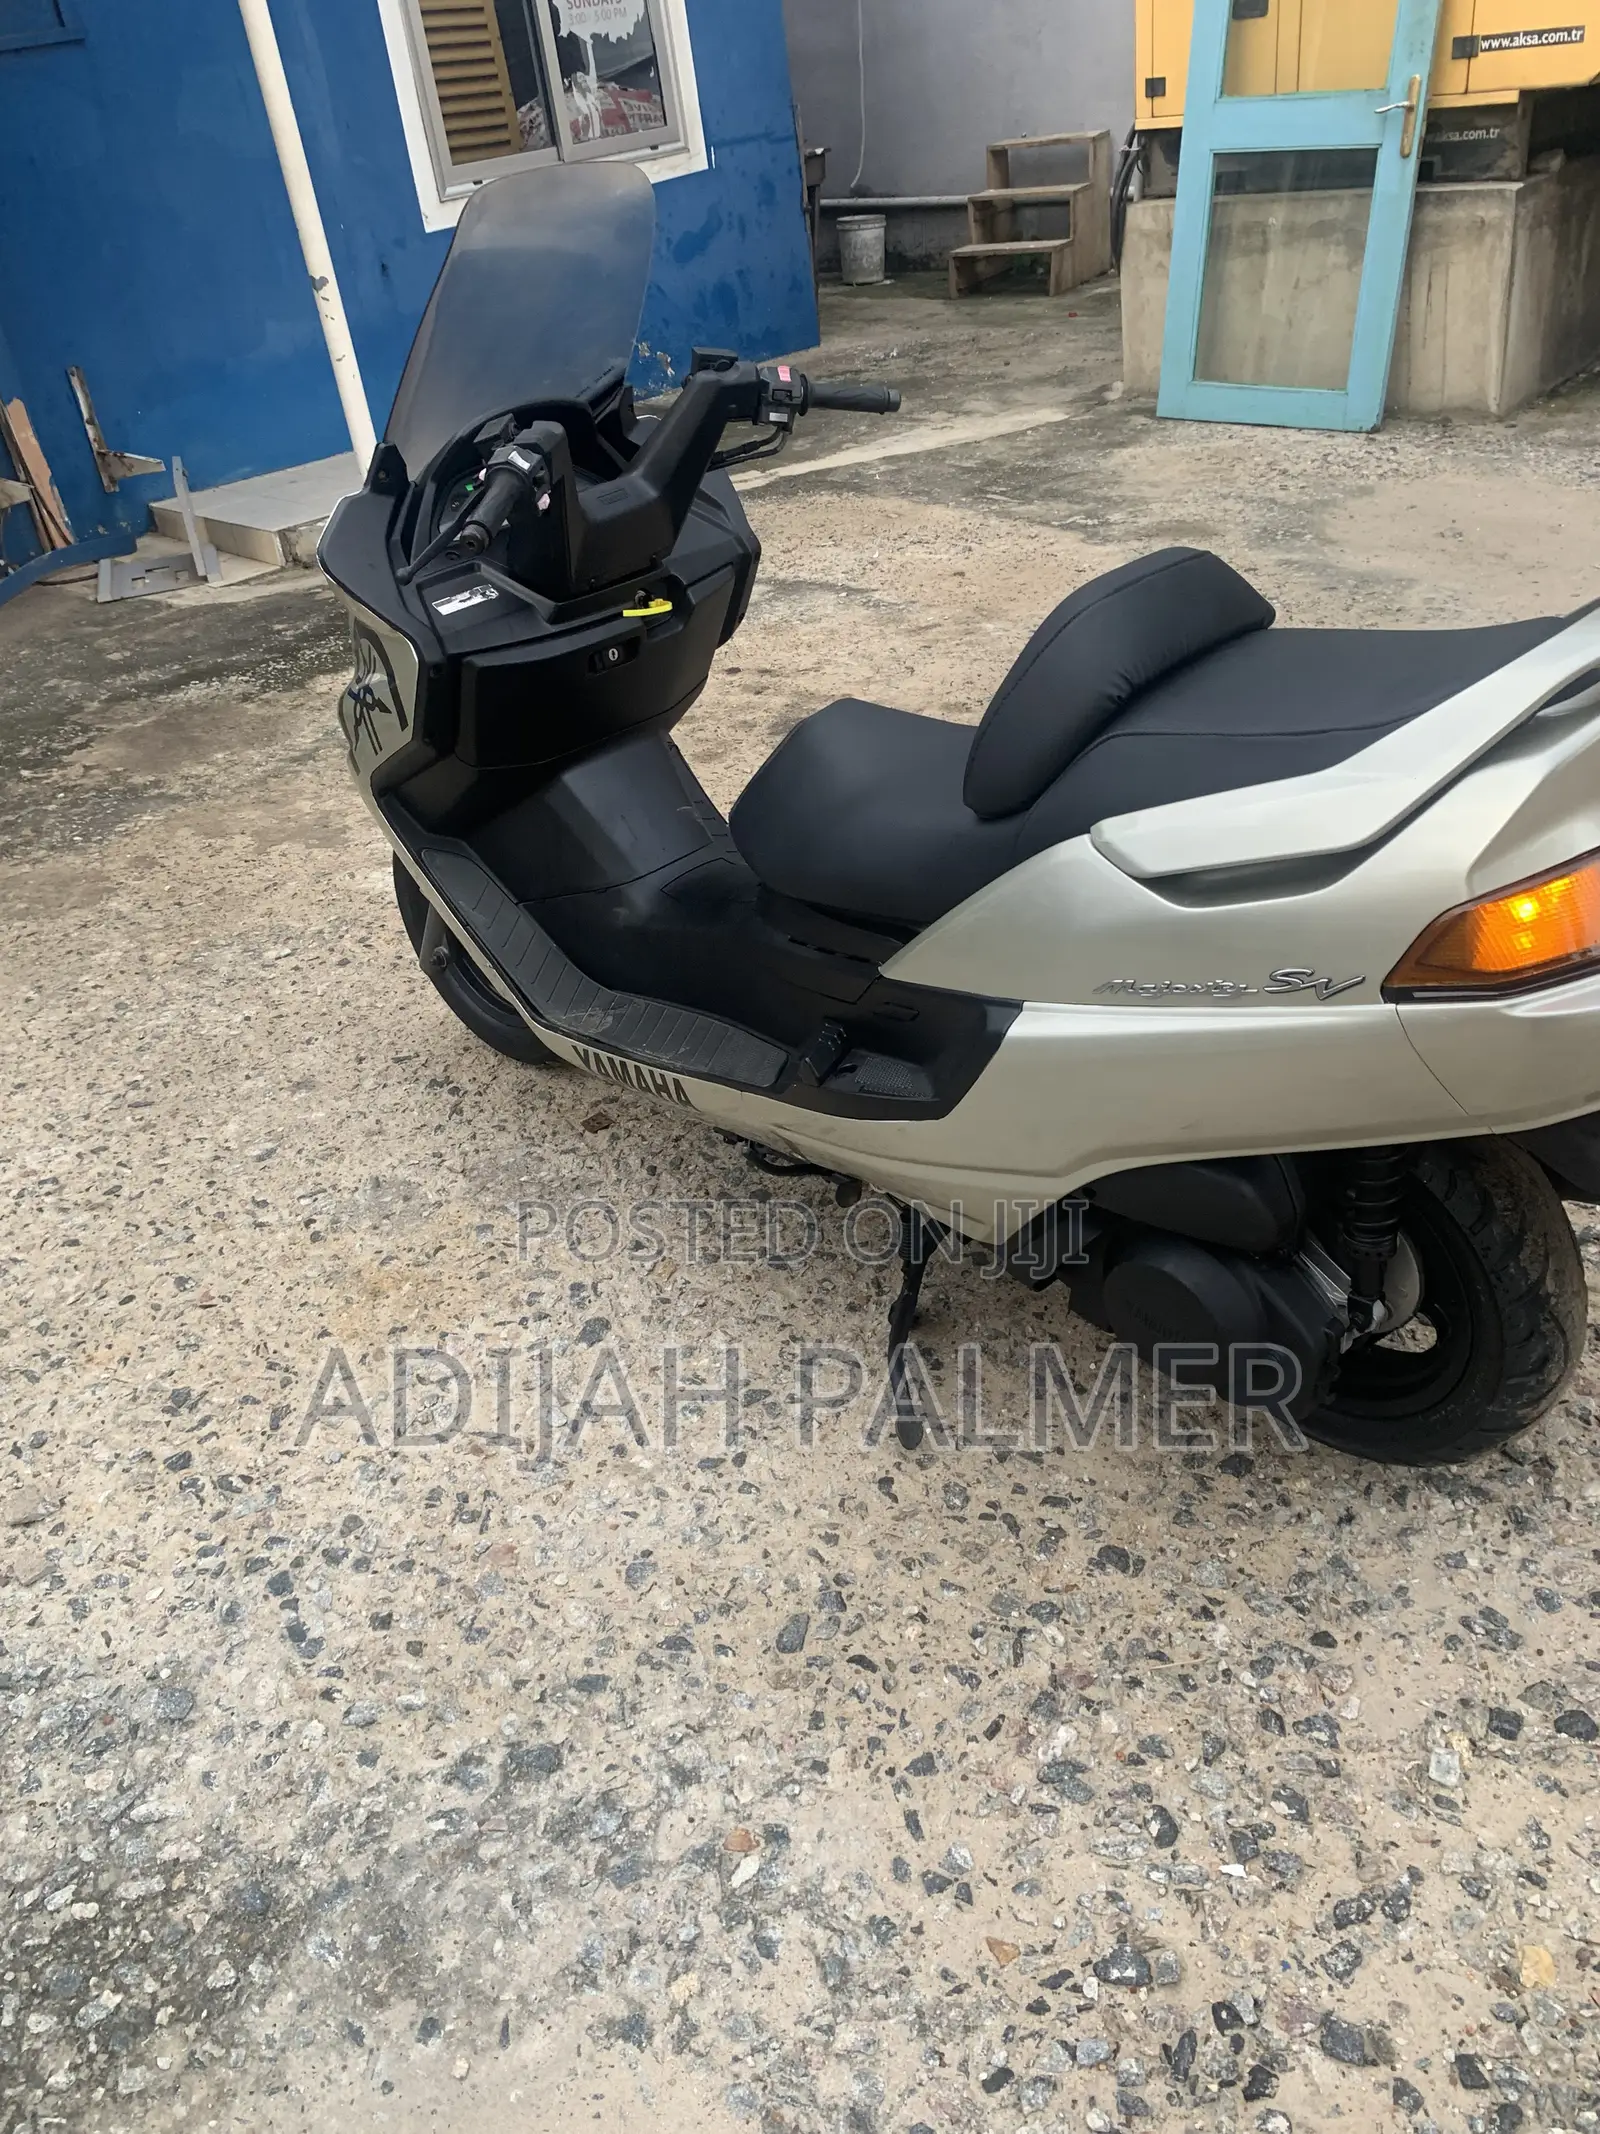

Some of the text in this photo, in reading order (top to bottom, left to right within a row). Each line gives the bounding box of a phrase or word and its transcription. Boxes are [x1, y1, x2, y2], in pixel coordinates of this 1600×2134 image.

[566, 0, 622, 10] SUNDA
[1481, 28, 1584, 50] www.aksa.com.tr
[1264, 968, 1366, 1000] SV
[571, 1044, 701, 1112] YAMAHA
